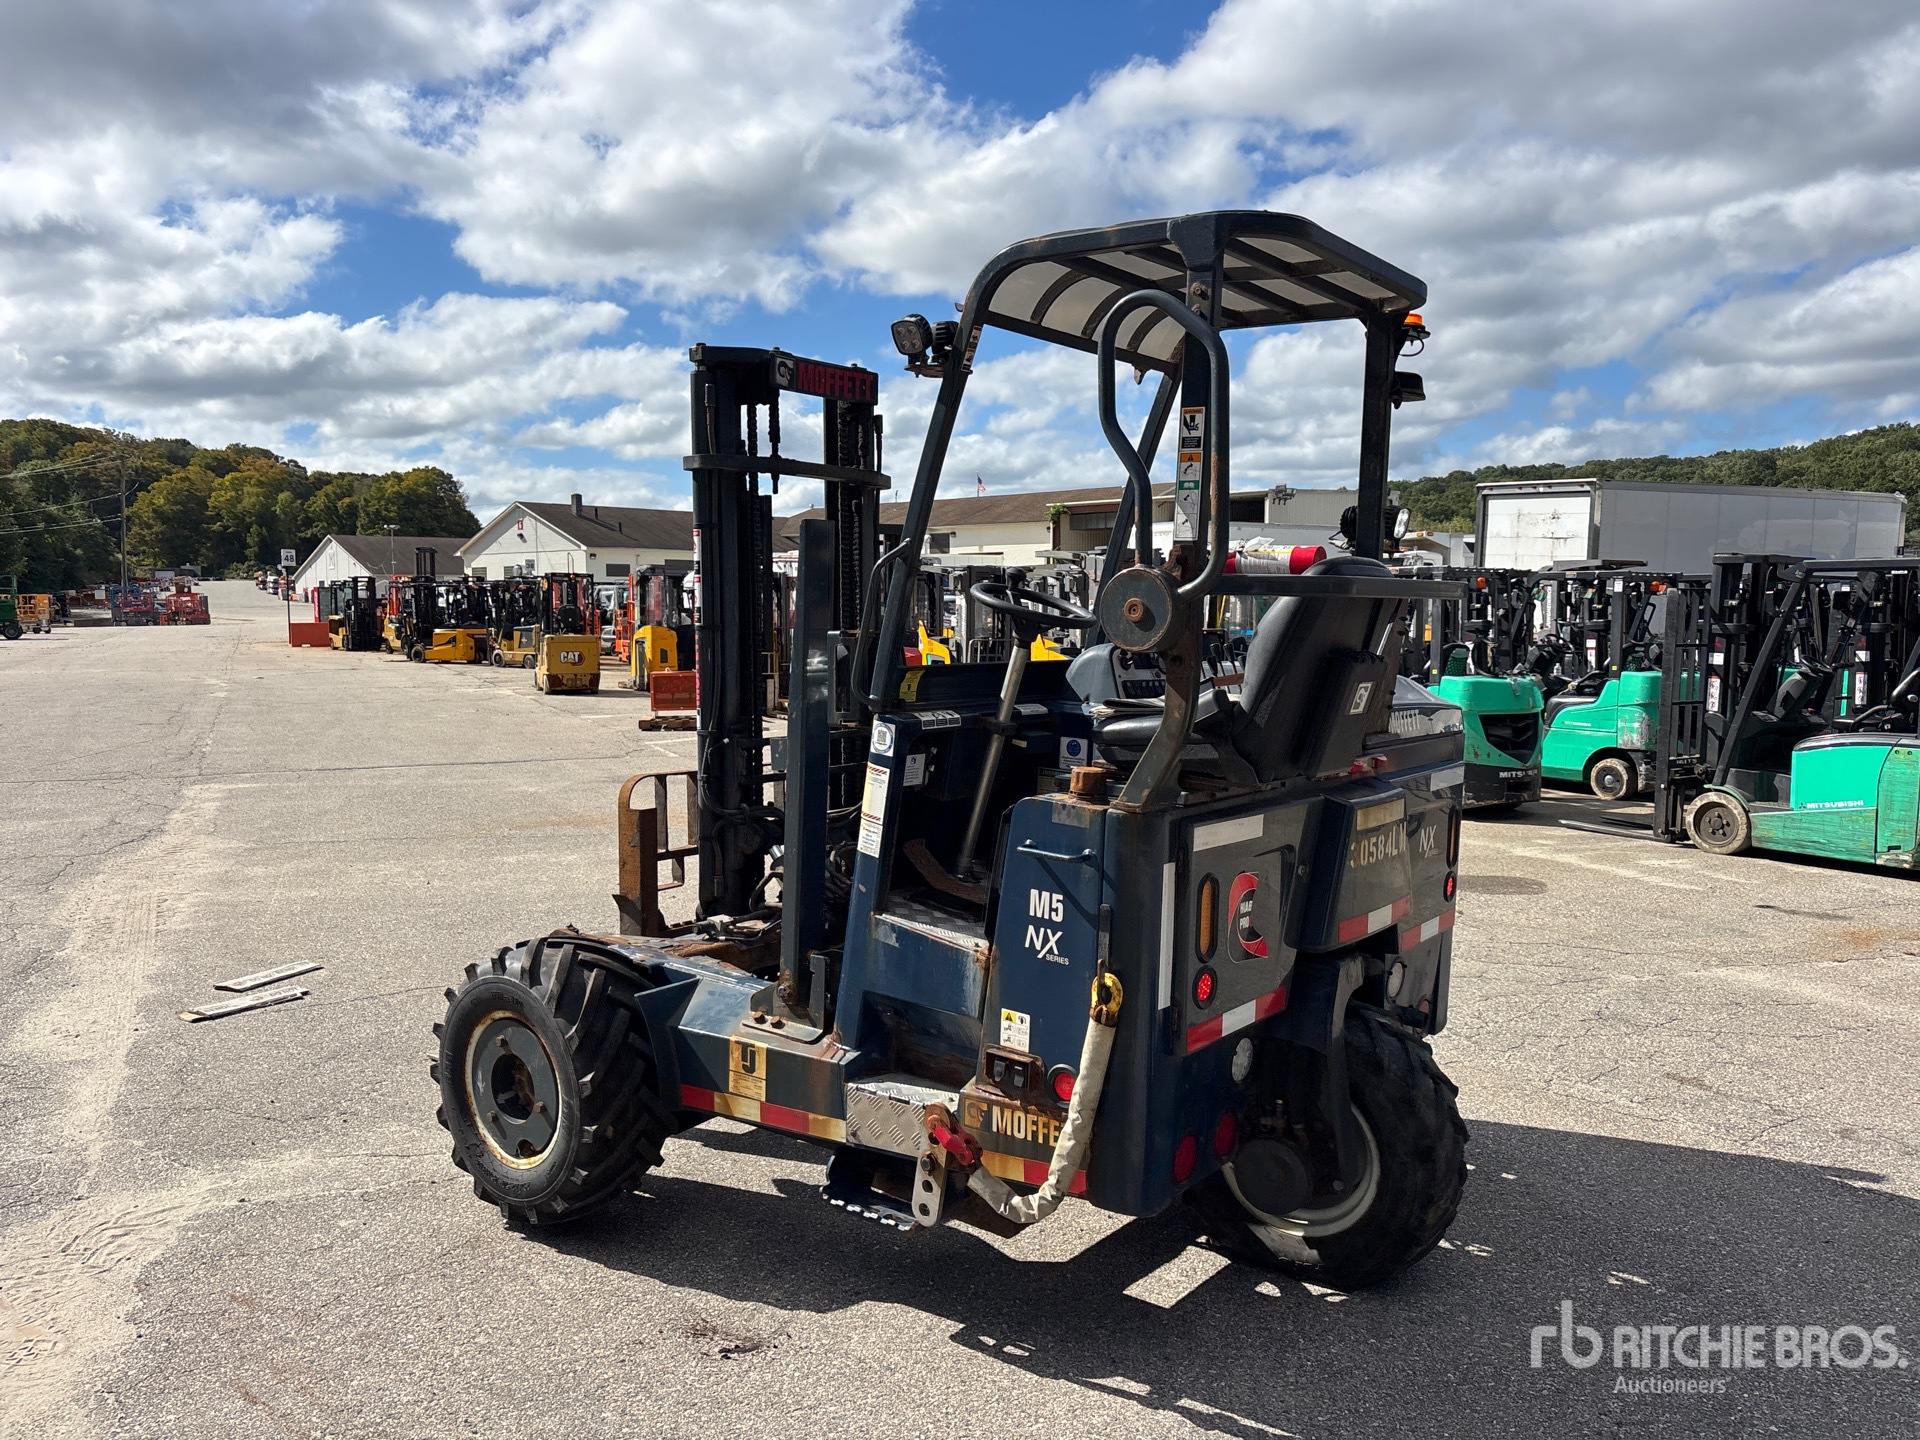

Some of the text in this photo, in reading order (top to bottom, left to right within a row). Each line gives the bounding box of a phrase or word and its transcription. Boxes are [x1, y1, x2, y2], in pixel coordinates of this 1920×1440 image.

[797, 362, 873, 400] MOFFETT
[284, 554, 294, 563] 48
[560, 651, 580, 663] CAT
[1806, 800, 1864, 809] MITSUBISHI
[1419, 825, 1437, 858] NX
[1029, 888, 1064, 923] M5
[1025, 924, 1064, 959] NX
[1045, 953, 1070, 966] SERIES
